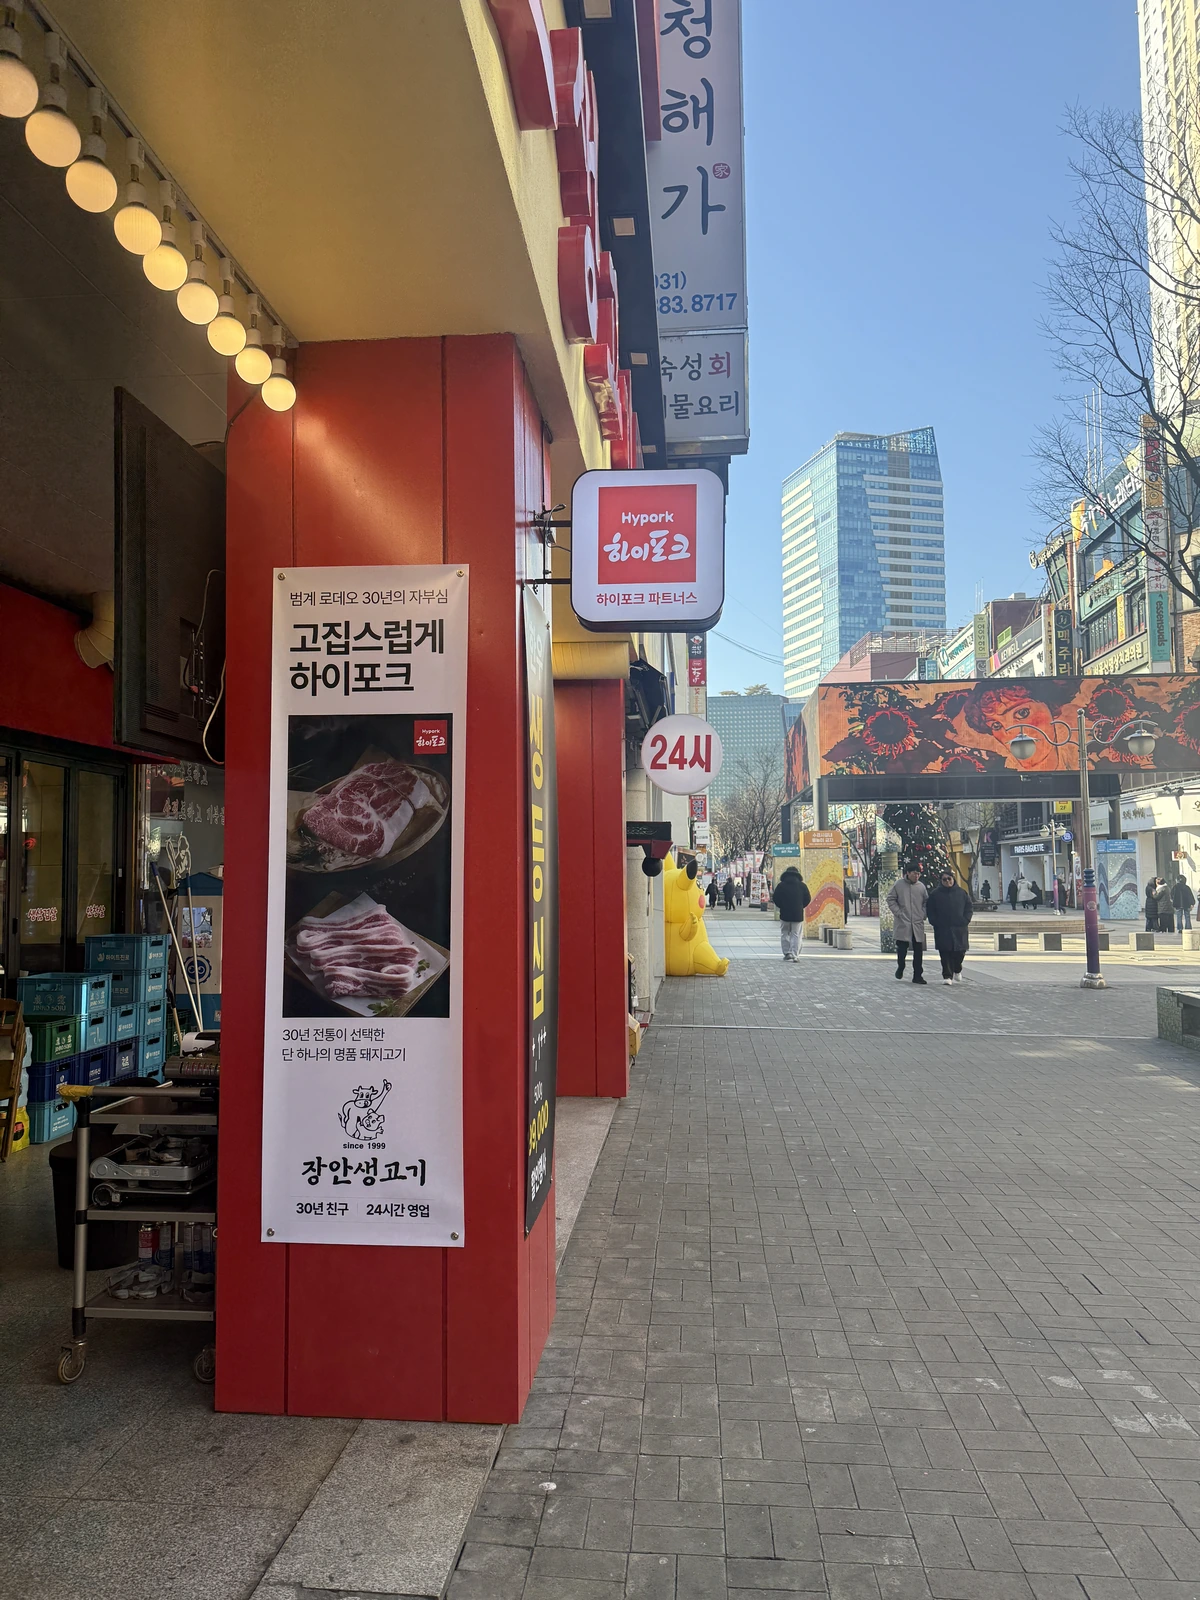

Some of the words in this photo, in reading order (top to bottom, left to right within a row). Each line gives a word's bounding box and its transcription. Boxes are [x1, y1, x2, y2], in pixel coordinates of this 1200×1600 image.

[660, 0, 726, 235] 청해가
[656, 293, 738, 315] 83.8717
[621, 511, 674, 526] Hypork
[603, 530, 691, 562] 하이포크
[290, 591, 316, 606] 범계
[319, 591, 359, 605] 로데오
[362, 590, 406, 604] 30년의
[409, 589, 448, 604] 자부심
[596, 592, 645, 606] 하이포크
[648, 592, 698, 605] 파트너스
[289, 618, 444, 655] 고집스럽게
[289, 661, 414, 696] 하이포크
[415, 735, 446, 747] 하이포크
[650, 734, 712, 773] 24시
[1014, 845, 1025, 854] PARIS
[1025, 843, 1045, 853] BAGUETTE
[529, 693, 546, 1021] 생등심
[282, 1028, 310, 1042] 30년
[312, 1028, 347, 1042] 전통이
[350, 1028, 385, 1042] 선택한
[282, 1048, 294, 1062] 단
[296, 1047, 331, 1062] 하나의
[334, 1047, 357, 1062] 명품
[359, 1047, 406, 1062] 돼지고기
[342, 1142, 364, 1150] since
[367, 1142, 386, 1150] 1999
[301, 1156, 427, 1187] 장안생고기
[296, 1202, 323, 1216] 30년
[326, 1202, 349, 1216] 친구
[366, 1203, 405, 1217] 24시간
[407, 1204, 430, 1218] 영업
